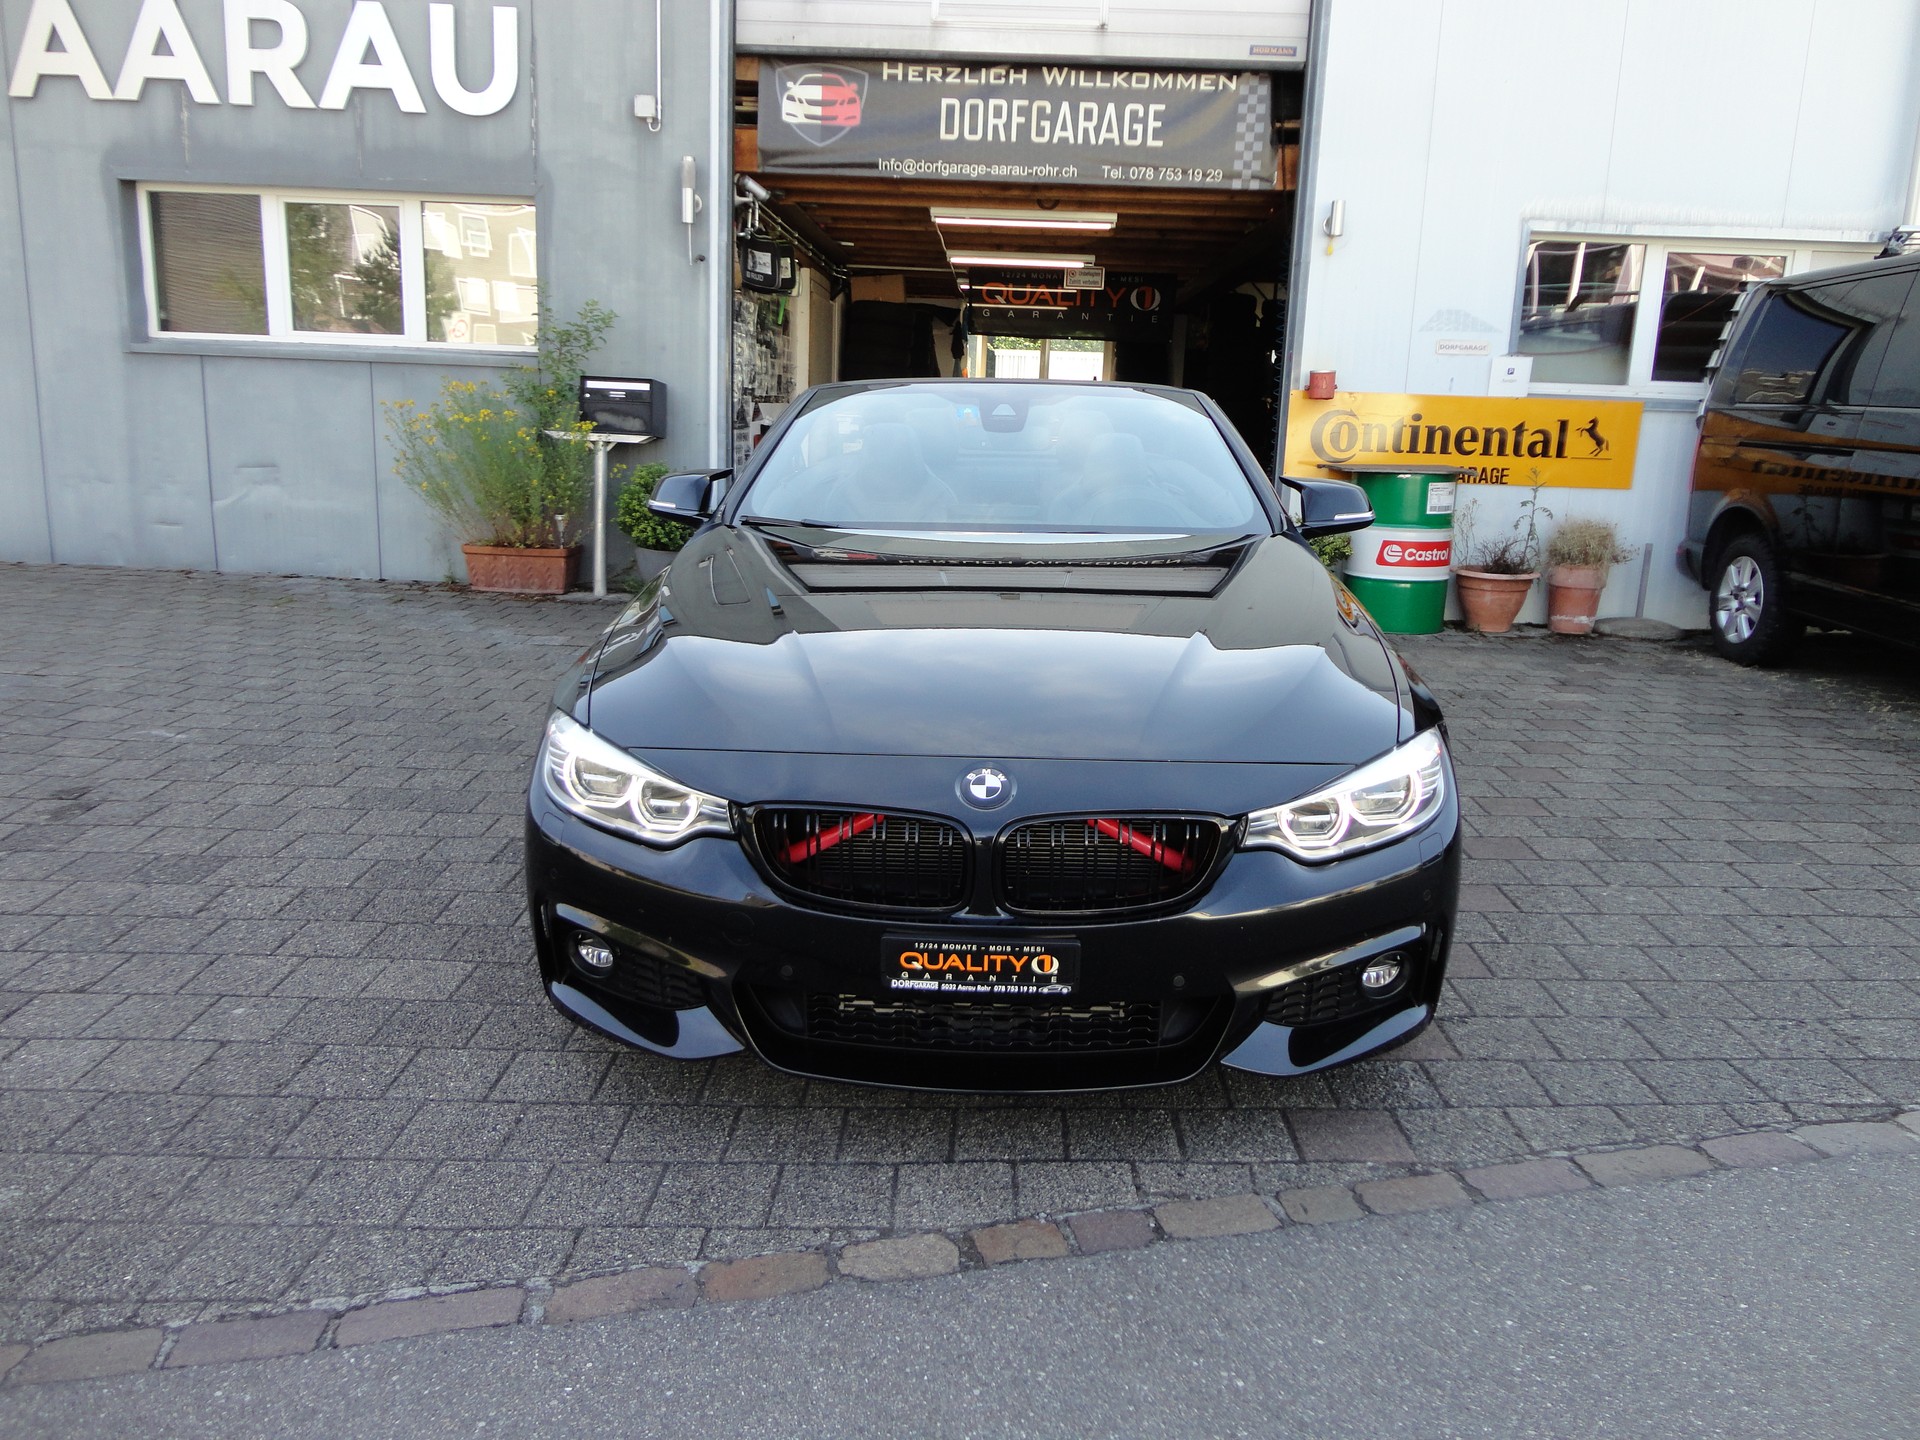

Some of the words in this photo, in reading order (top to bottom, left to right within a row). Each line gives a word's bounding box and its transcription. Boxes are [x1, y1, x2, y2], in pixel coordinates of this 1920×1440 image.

[8, 0, 518, 117] AARAU
[882, 62, 1028, 85] HERZLICH
[1042, 66, 1238, 91] WILLKOMMEN
[939, 97, 1166, 148] DORFGARAGE
[878, 158, 1078, 178] Info@dorfgarage-aarau-rohr.ch
[1102, 164, 1125, 179] Tel.
[1130, 166, 1154, 180] 078
[1159, 167, 1182, 181] 753
[1187, 168, 1202, 181] 19
[1206, 169, 1223, 182] 29
[1031, 272, 1064, 280] MONAT
[982, 282, 1126, 308] QUALITY
[982, 308, 1158, 323] GARANTIE
[1311, 409, 1569, 463] Continental
[1456, 465, 1510, 485] ARAGE
[1404, 548, 1450, 561] Castrol
[966, 768, 1008, 782] BMW
[941, 943, 978, 951] MONATE
[900, 951, 1029, 973] QUALITY
[901, 971, 1058, 983] GARANTIE
[941, 983, 957, 991] 5032
[993, 985, 1006, 993] 078
